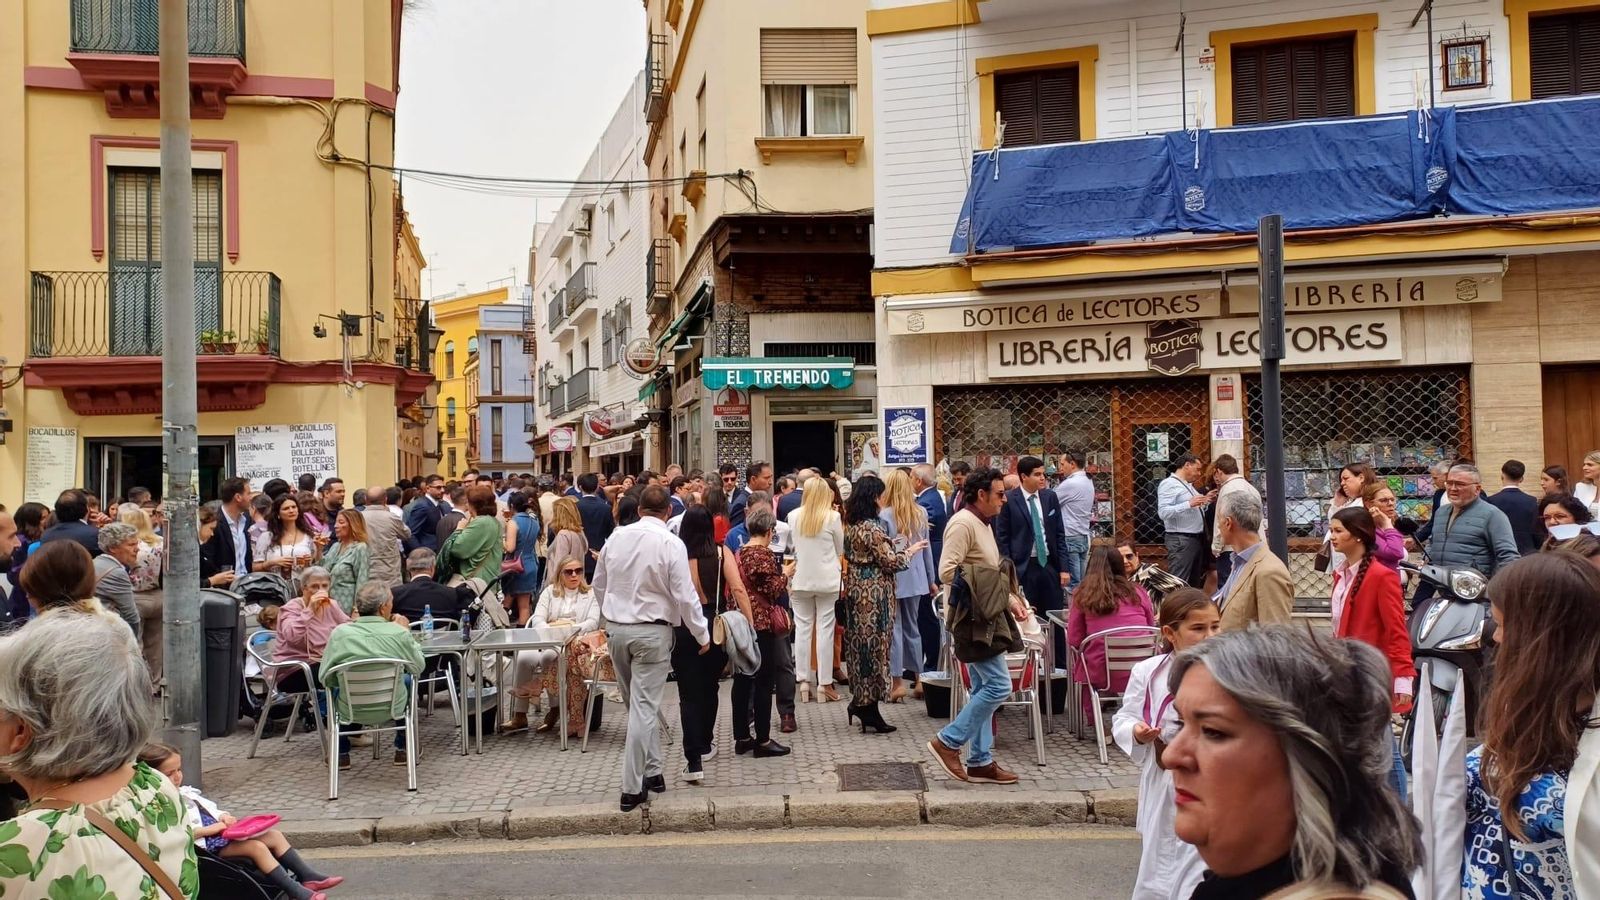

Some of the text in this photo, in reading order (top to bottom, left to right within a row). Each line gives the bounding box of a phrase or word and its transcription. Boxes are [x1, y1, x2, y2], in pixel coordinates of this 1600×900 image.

[1284, 277, 1426, 307] IBRERÍA
[963, 295, 1200, 327] BOTICA de LECTORES
[999, 331, 1131, 366] LIBRERÍA
[1150, 332, 1198, 354] BOTICA
[727, 370, 830, 385] EL TREMENDO
[28, 427, 75, 436] BOCADILLOS
[290, 424, 333, 432] BOCADILLOS
[891, 424, 921, 437] BOTICA
[294, 432, 313, 440] AGUA
[291, 447, 325, 457] BOLLERÍA
[312, 456, 335, 464] SECOS
[293, 464, 335, 473] BOTELLINES
